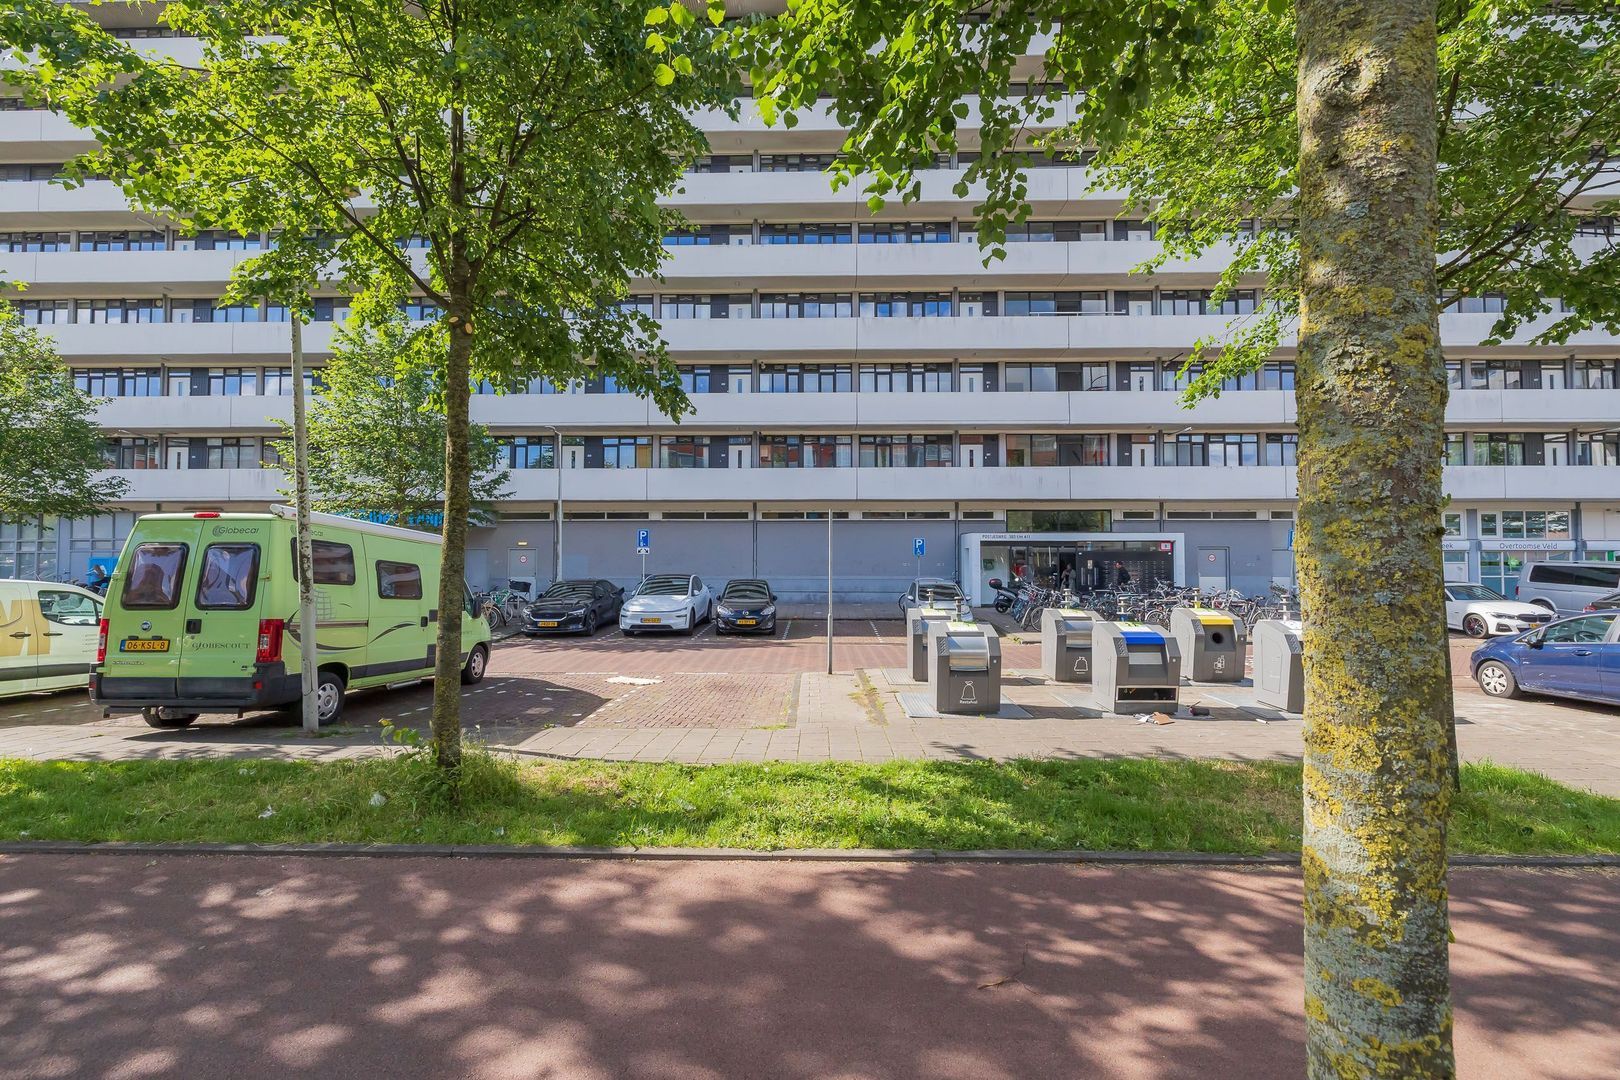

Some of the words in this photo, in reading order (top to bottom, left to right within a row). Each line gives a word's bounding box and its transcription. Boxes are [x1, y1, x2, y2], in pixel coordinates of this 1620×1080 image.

[218, 526, 260, 534] Globecar
[640, 531, 647, 539] P
[916, 540, 923, 548] P
[127, 640, 165, 650] 06-KSL-8
